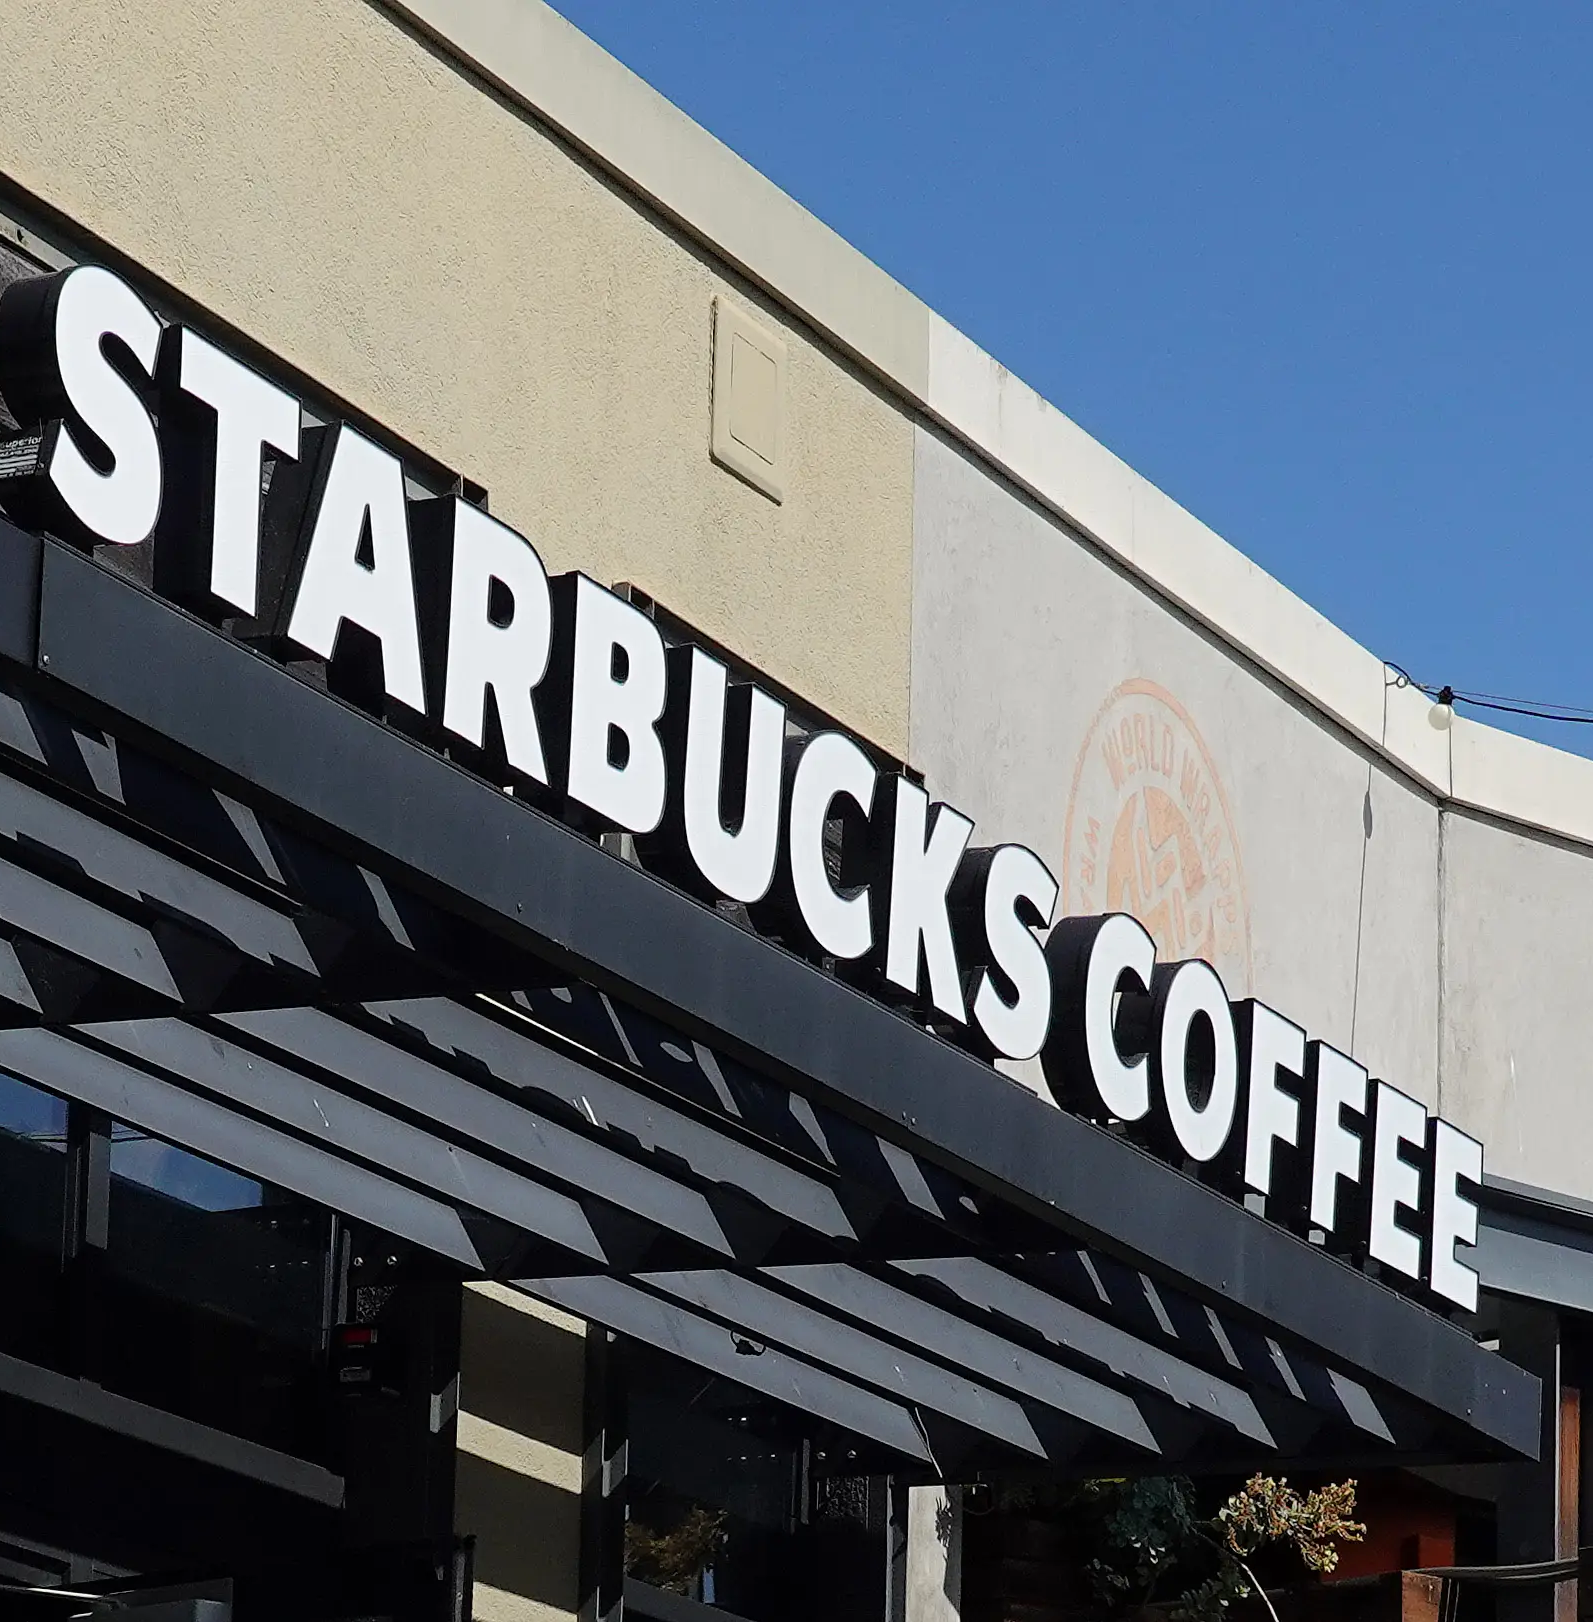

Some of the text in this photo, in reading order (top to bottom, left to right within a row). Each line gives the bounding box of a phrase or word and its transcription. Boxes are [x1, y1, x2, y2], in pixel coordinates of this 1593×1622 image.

[50, 264, 1484, 1314] STARBUCKS COFFEE
[1102, 713, 1175, 791] WORLD
